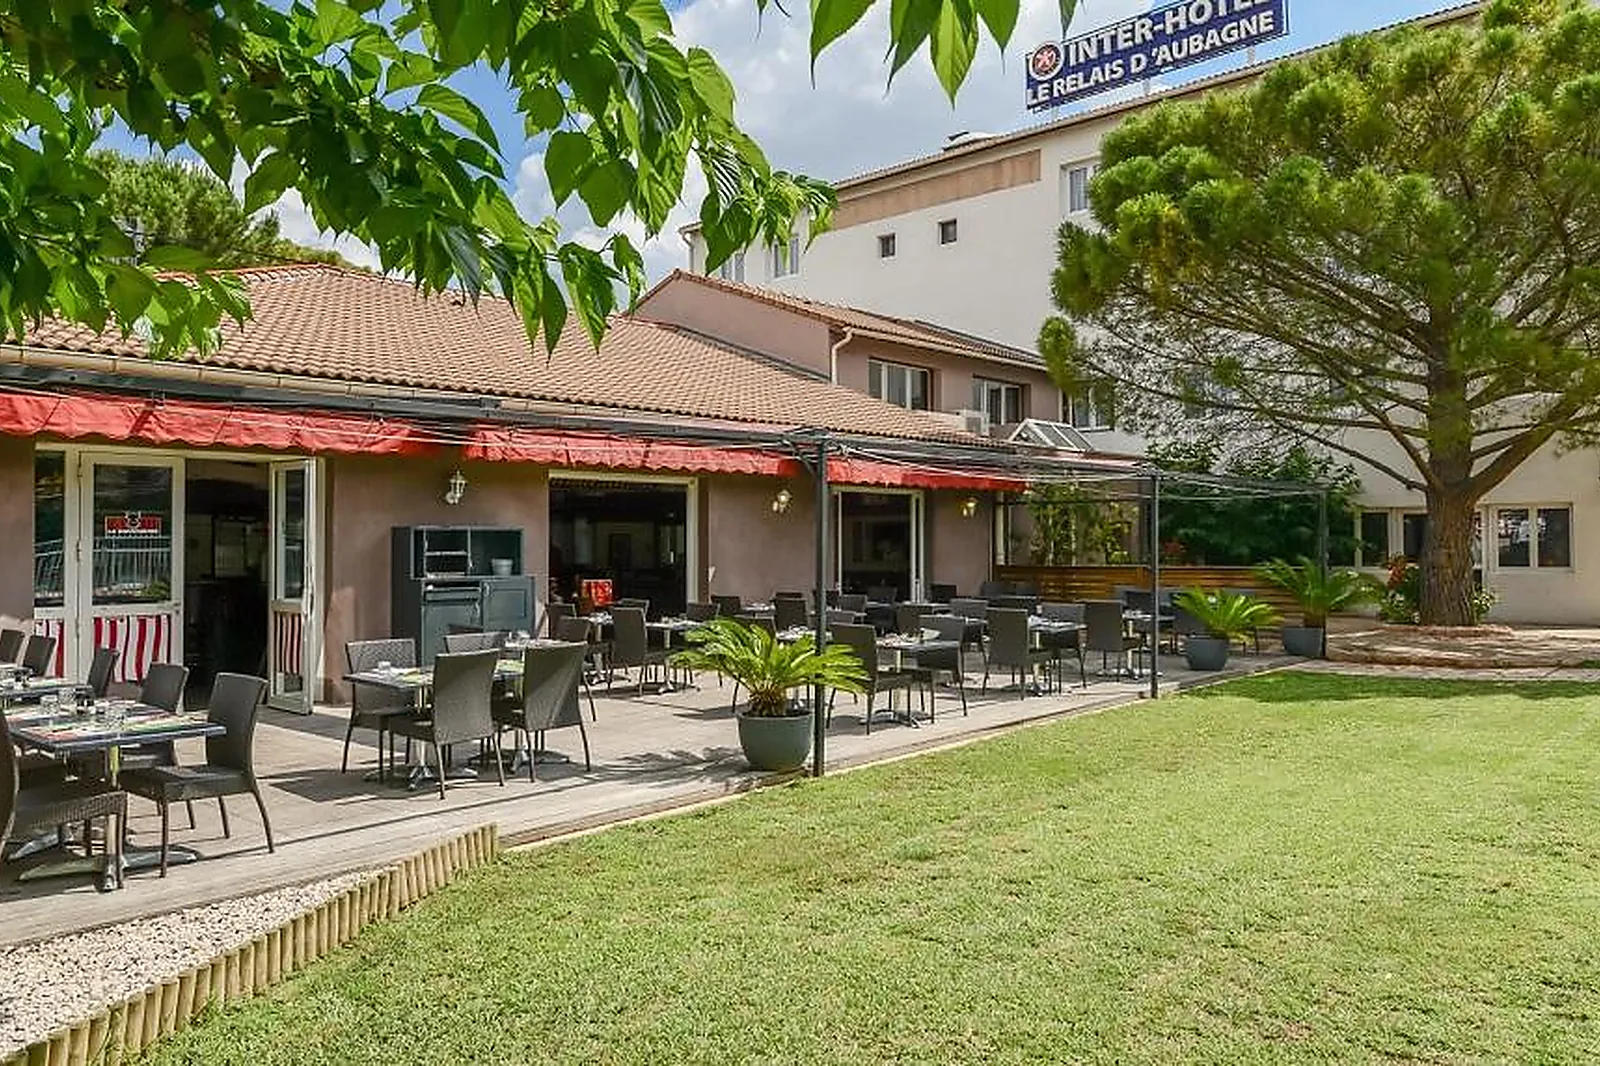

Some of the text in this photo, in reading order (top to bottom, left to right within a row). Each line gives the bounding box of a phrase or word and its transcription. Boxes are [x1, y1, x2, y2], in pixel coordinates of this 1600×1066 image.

[1068, 0, 1271, 67] INTER-HOT
[1028, 84, 1051, 105] LE
[1052, 59, 1124, 97] RELAIS
